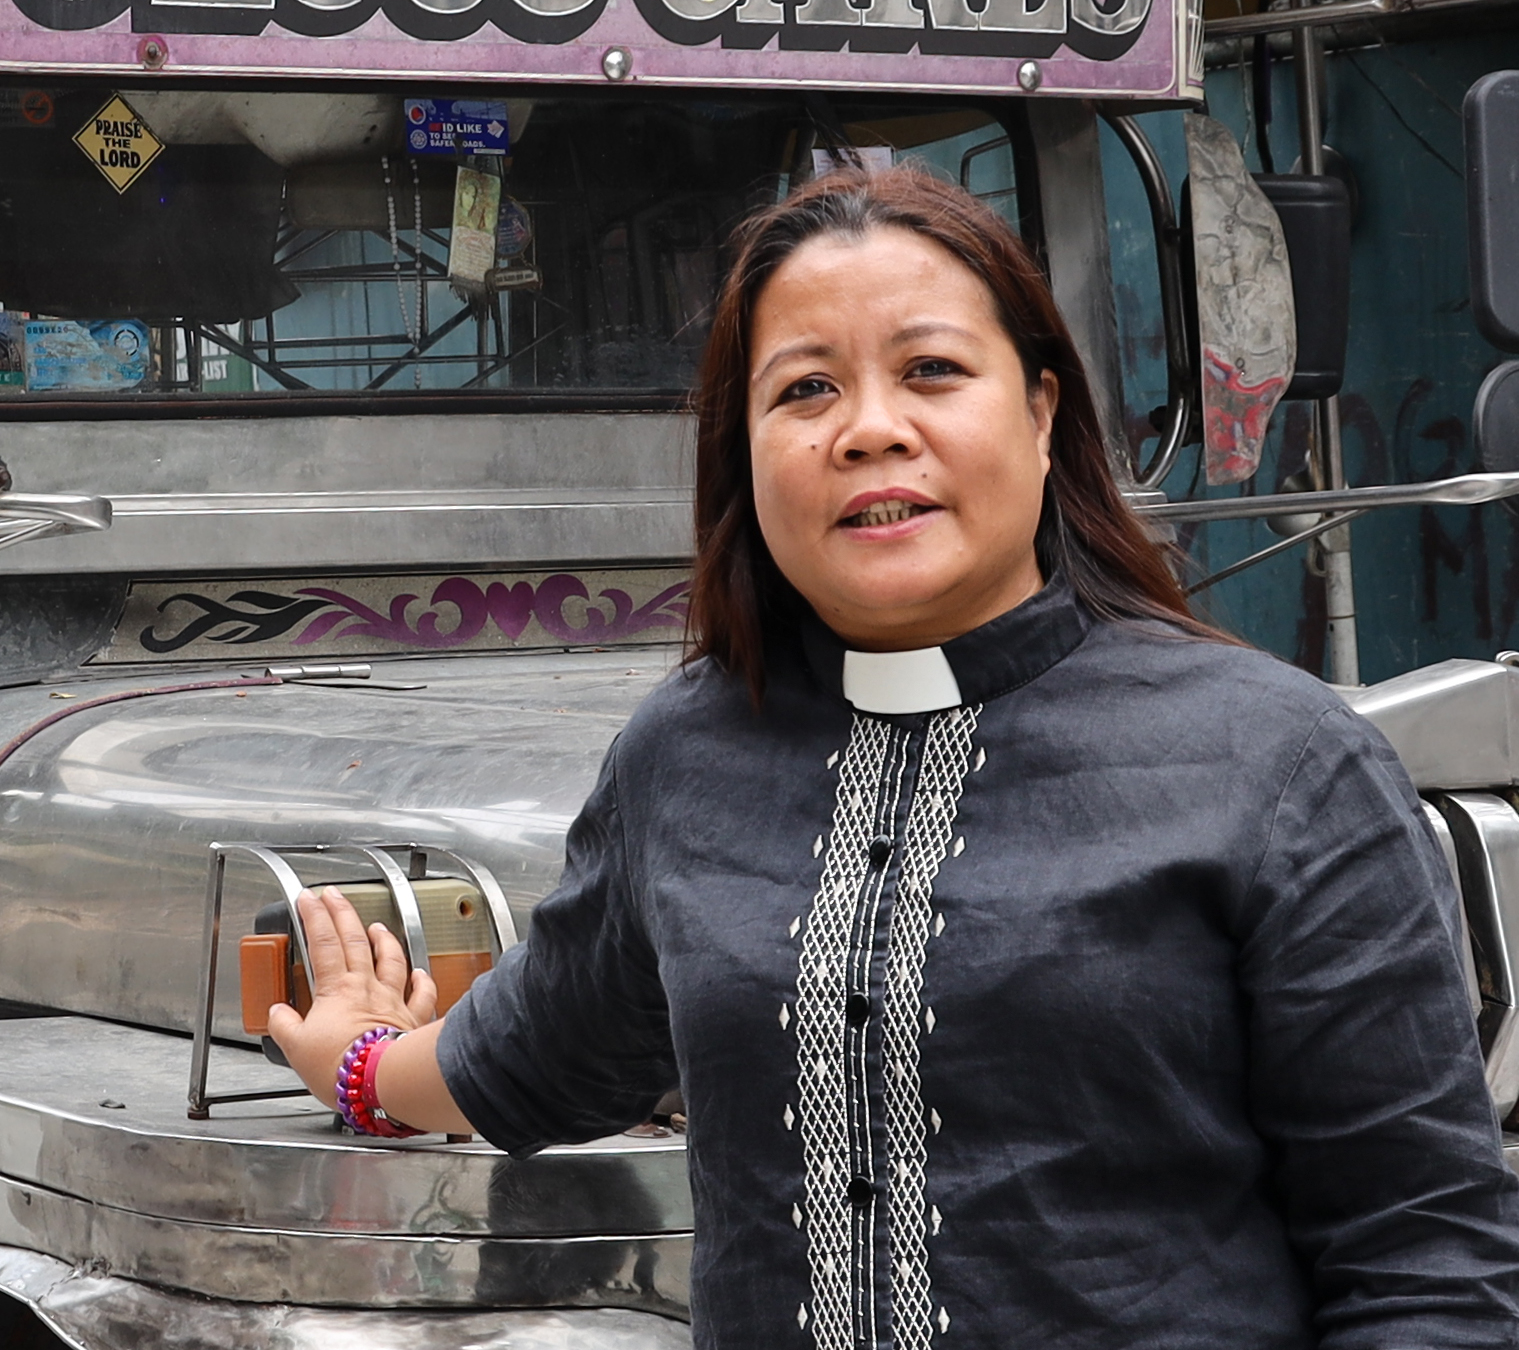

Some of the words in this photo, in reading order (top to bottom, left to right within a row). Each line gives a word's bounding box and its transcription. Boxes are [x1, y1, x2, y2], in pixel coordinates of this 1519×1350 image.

[95, 119, 143, 139] PRAISE
[456, 123, 483, 134] LIKE
[102, 137, 131, 149] THE
[460, 140, 487, 148] OADS.
[99, 149, 141, 169] LORD
